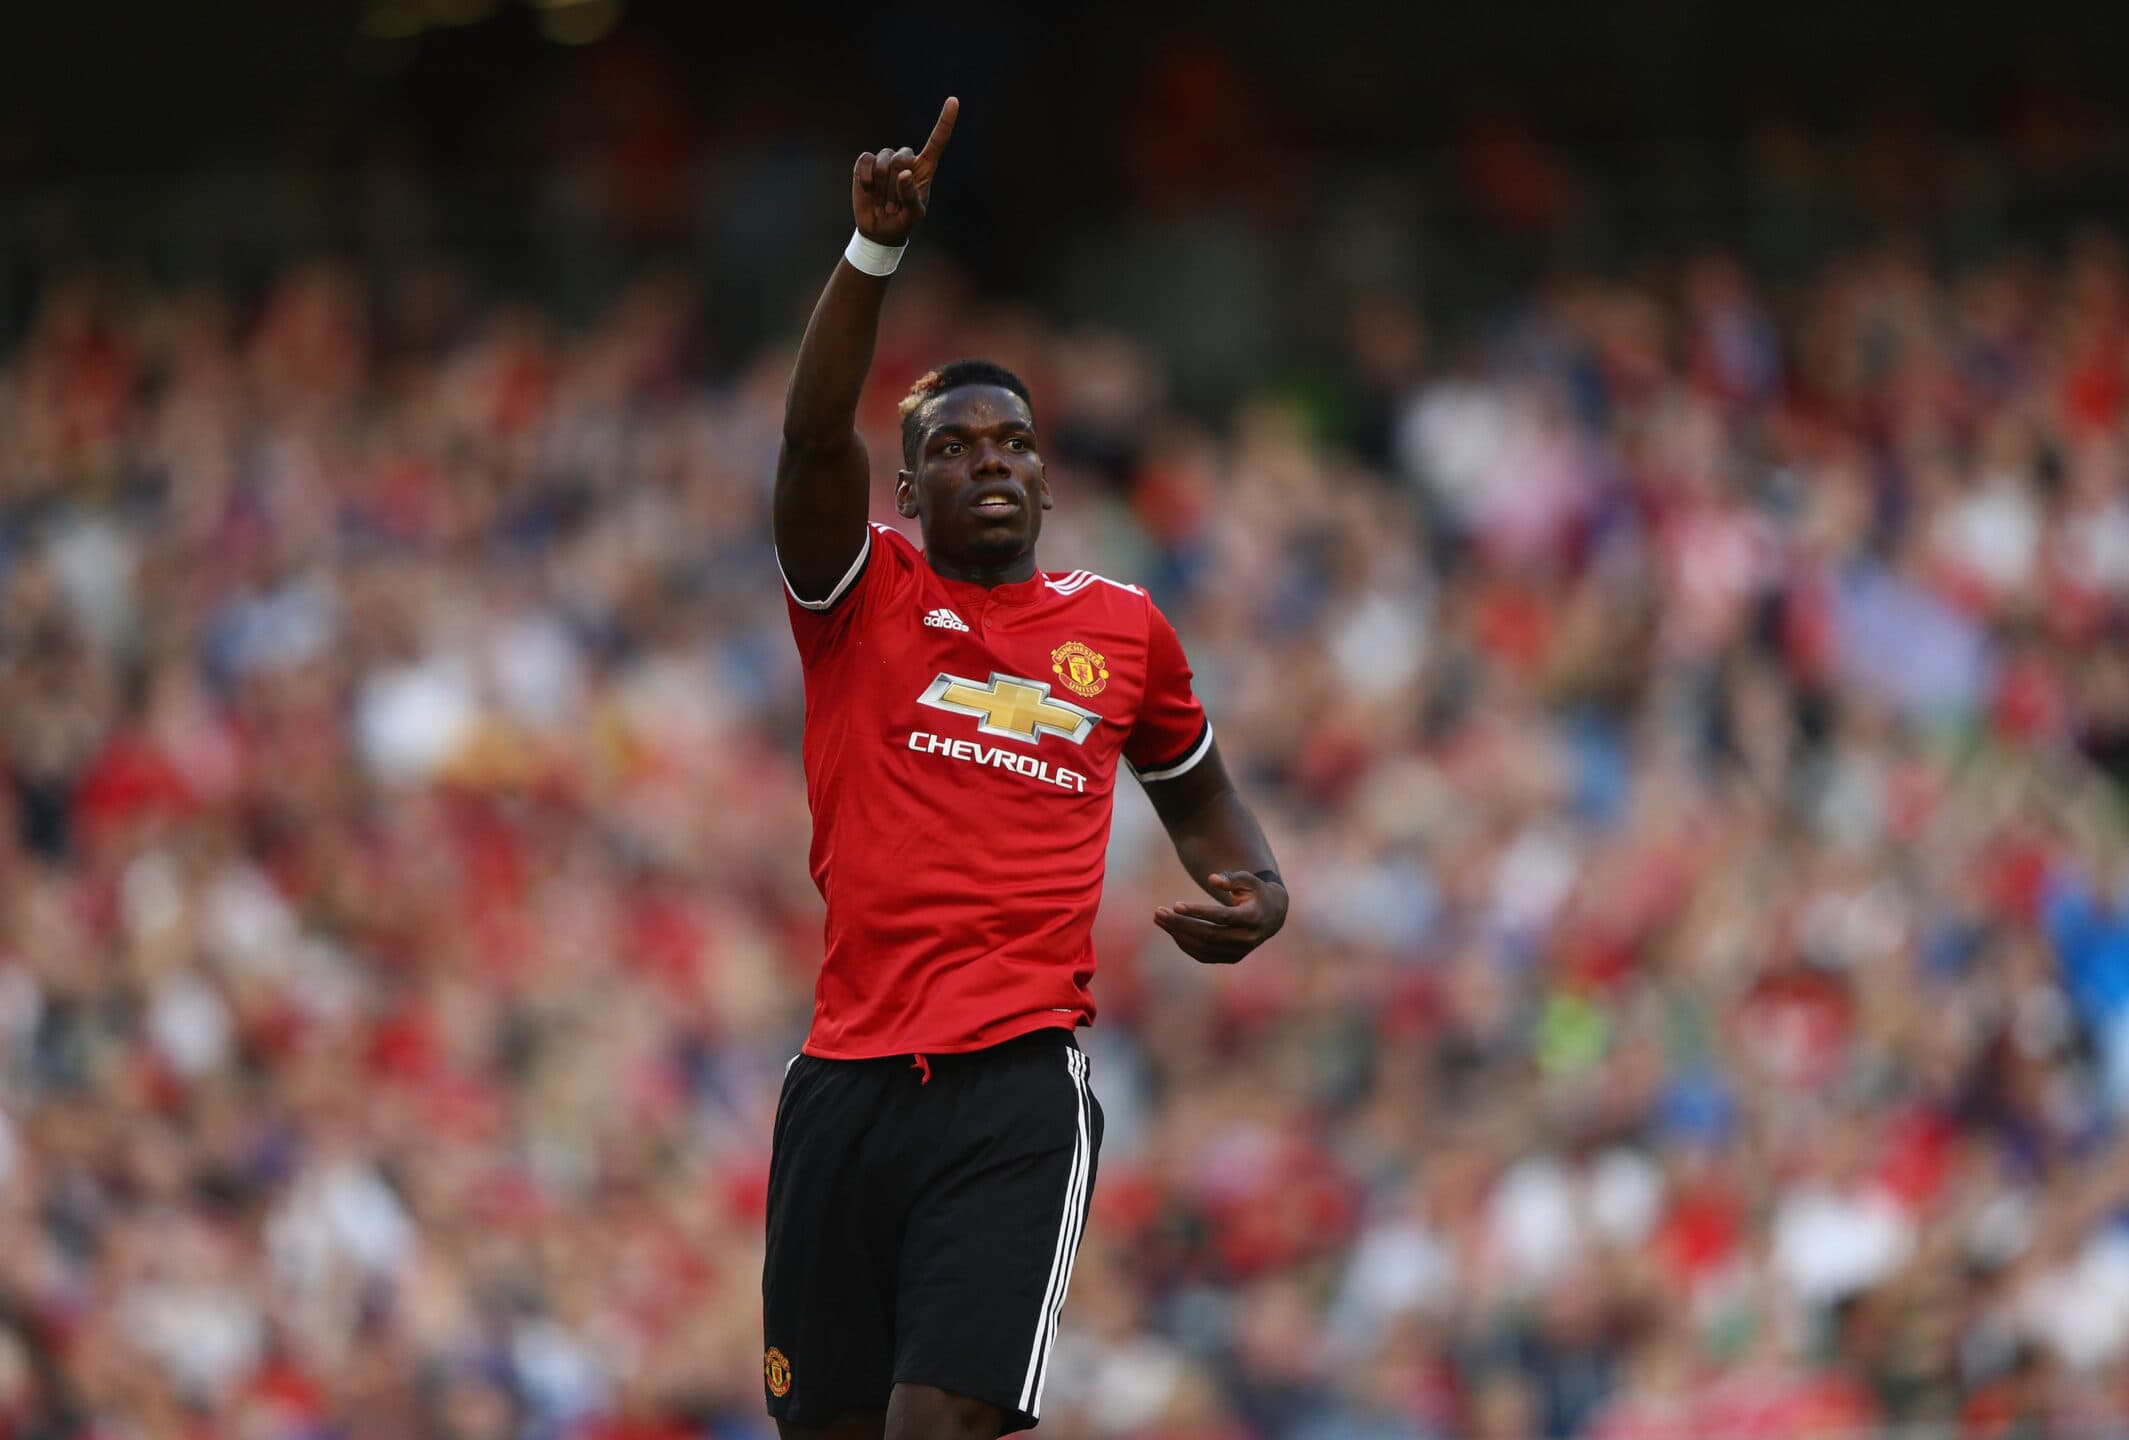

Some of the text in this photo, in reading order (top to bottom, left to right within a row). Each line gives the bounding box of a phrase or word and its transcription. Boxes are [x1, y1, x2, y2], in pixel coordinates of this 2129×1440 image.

[1055, 645, 1101, 666] MANCHESTER
[1069, 682, 1099, 693] UNITED
[908, 732, 1087, 792] CHEVROLET
